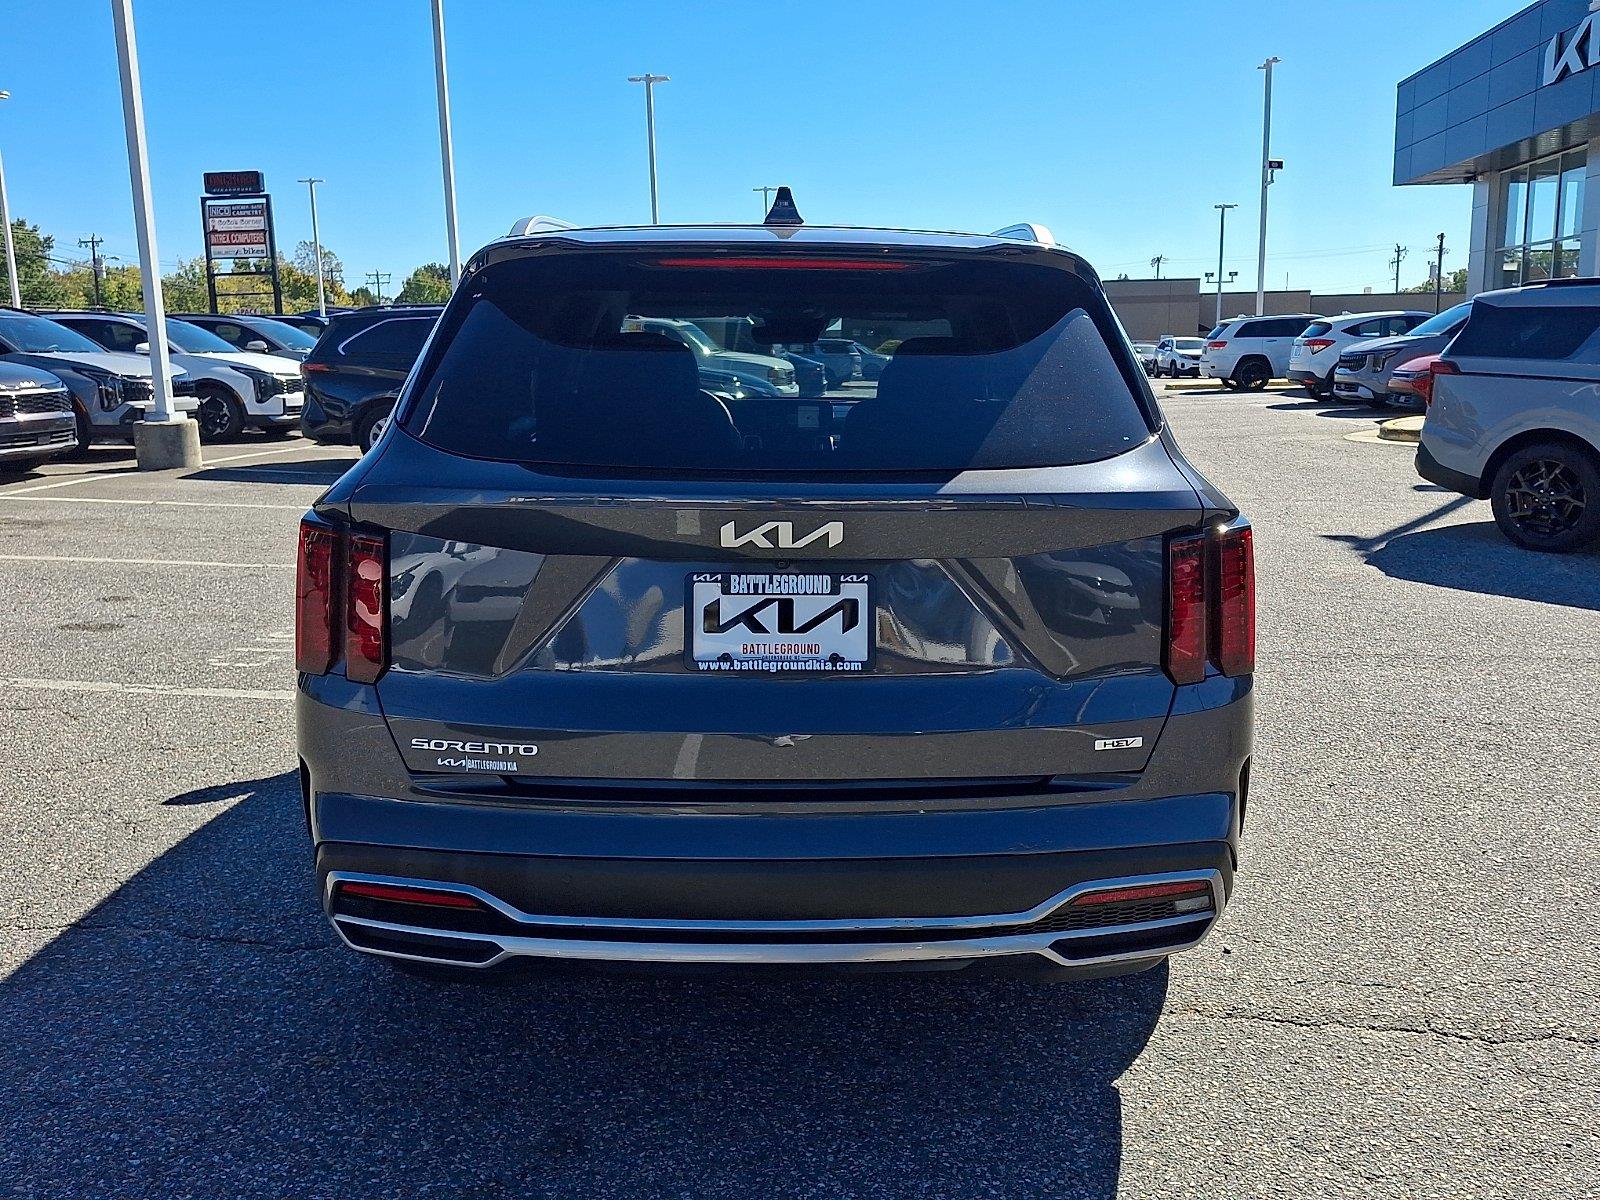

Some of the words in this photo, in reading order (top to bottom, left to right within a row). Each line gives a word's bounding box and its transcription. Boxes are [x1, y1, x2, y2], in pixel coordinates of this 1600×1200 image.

[1543, 9, 1600, 86] KI
[211, 206, 230, 215] NICO
[231, 232, 265, 243] COMPUTERS
[243, 247, 265, 255] bikes
[720, 520, 844, 548] KIA
[693, 573, 722, 582] KIA
[840, 574, 869, 582] KIA
[730, 574, 832, 595] BATTLEGROUND
[703, 597, 860, 635] KIA
[742, 643, 820, 655] BATTLEGROUND
[698, 659, 863, 673] www.battlegroundkia.com
[411, 738, 538, 756] SORENTO
[1103, 739, 1137, 748] HEV
[467, 758, 507, 771] BATTLEGROUND
[507, 761, 518, 772] KIA
